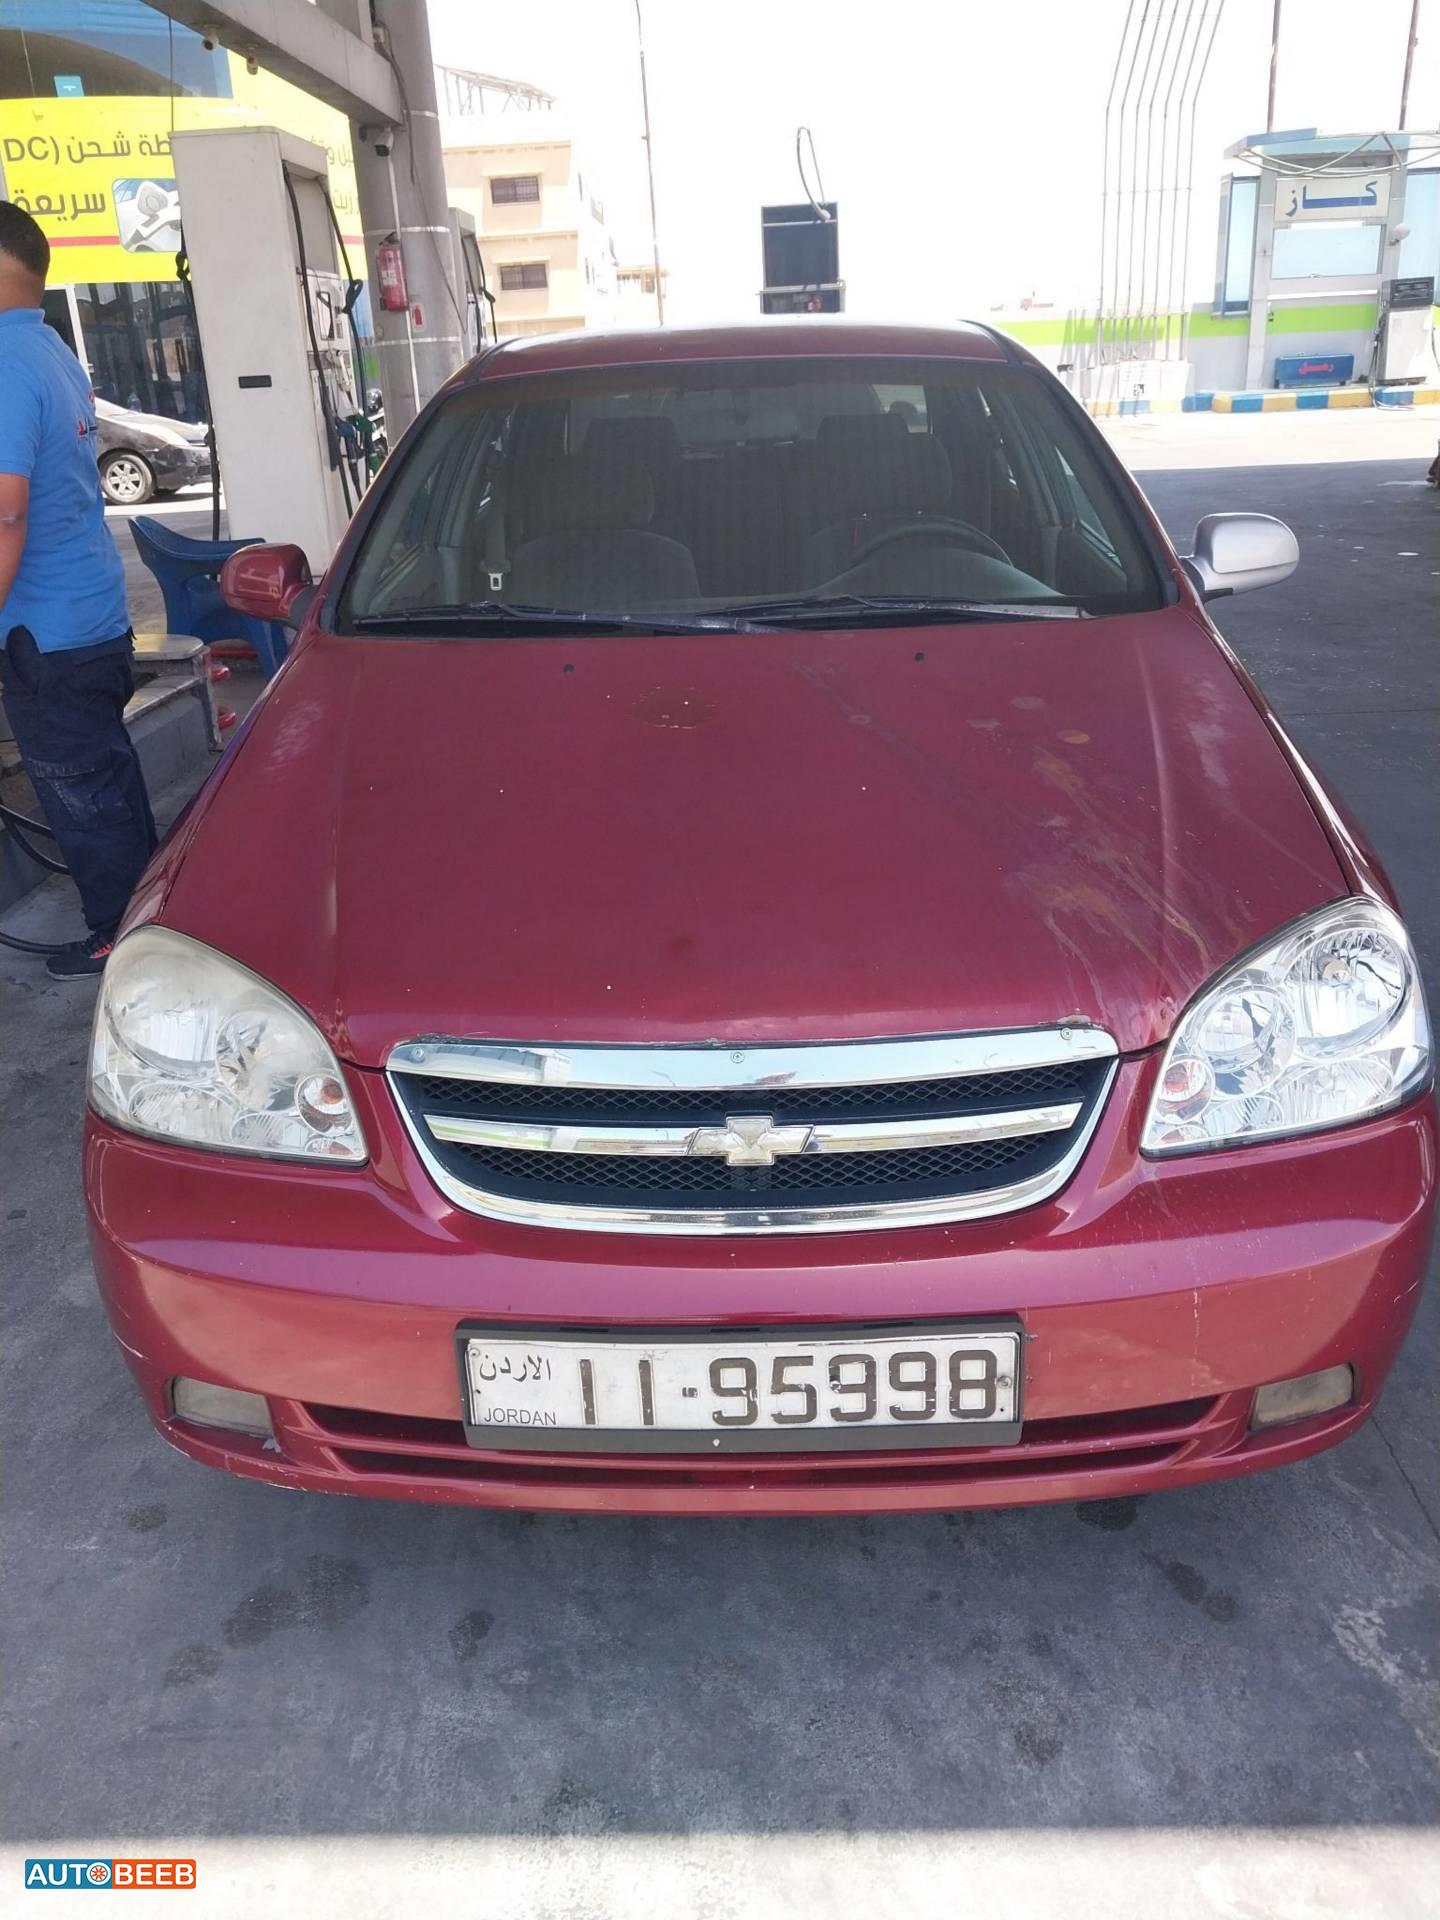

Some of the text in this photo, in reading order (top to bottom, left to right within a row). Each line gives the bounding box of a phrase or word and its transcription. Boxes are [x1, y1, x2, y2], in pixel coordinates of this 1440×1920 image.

[67, 131, 131, 164] شحن
[14, 189, 106, 221] سريعة
[484, 1407, 557, 1426] JORDAN
